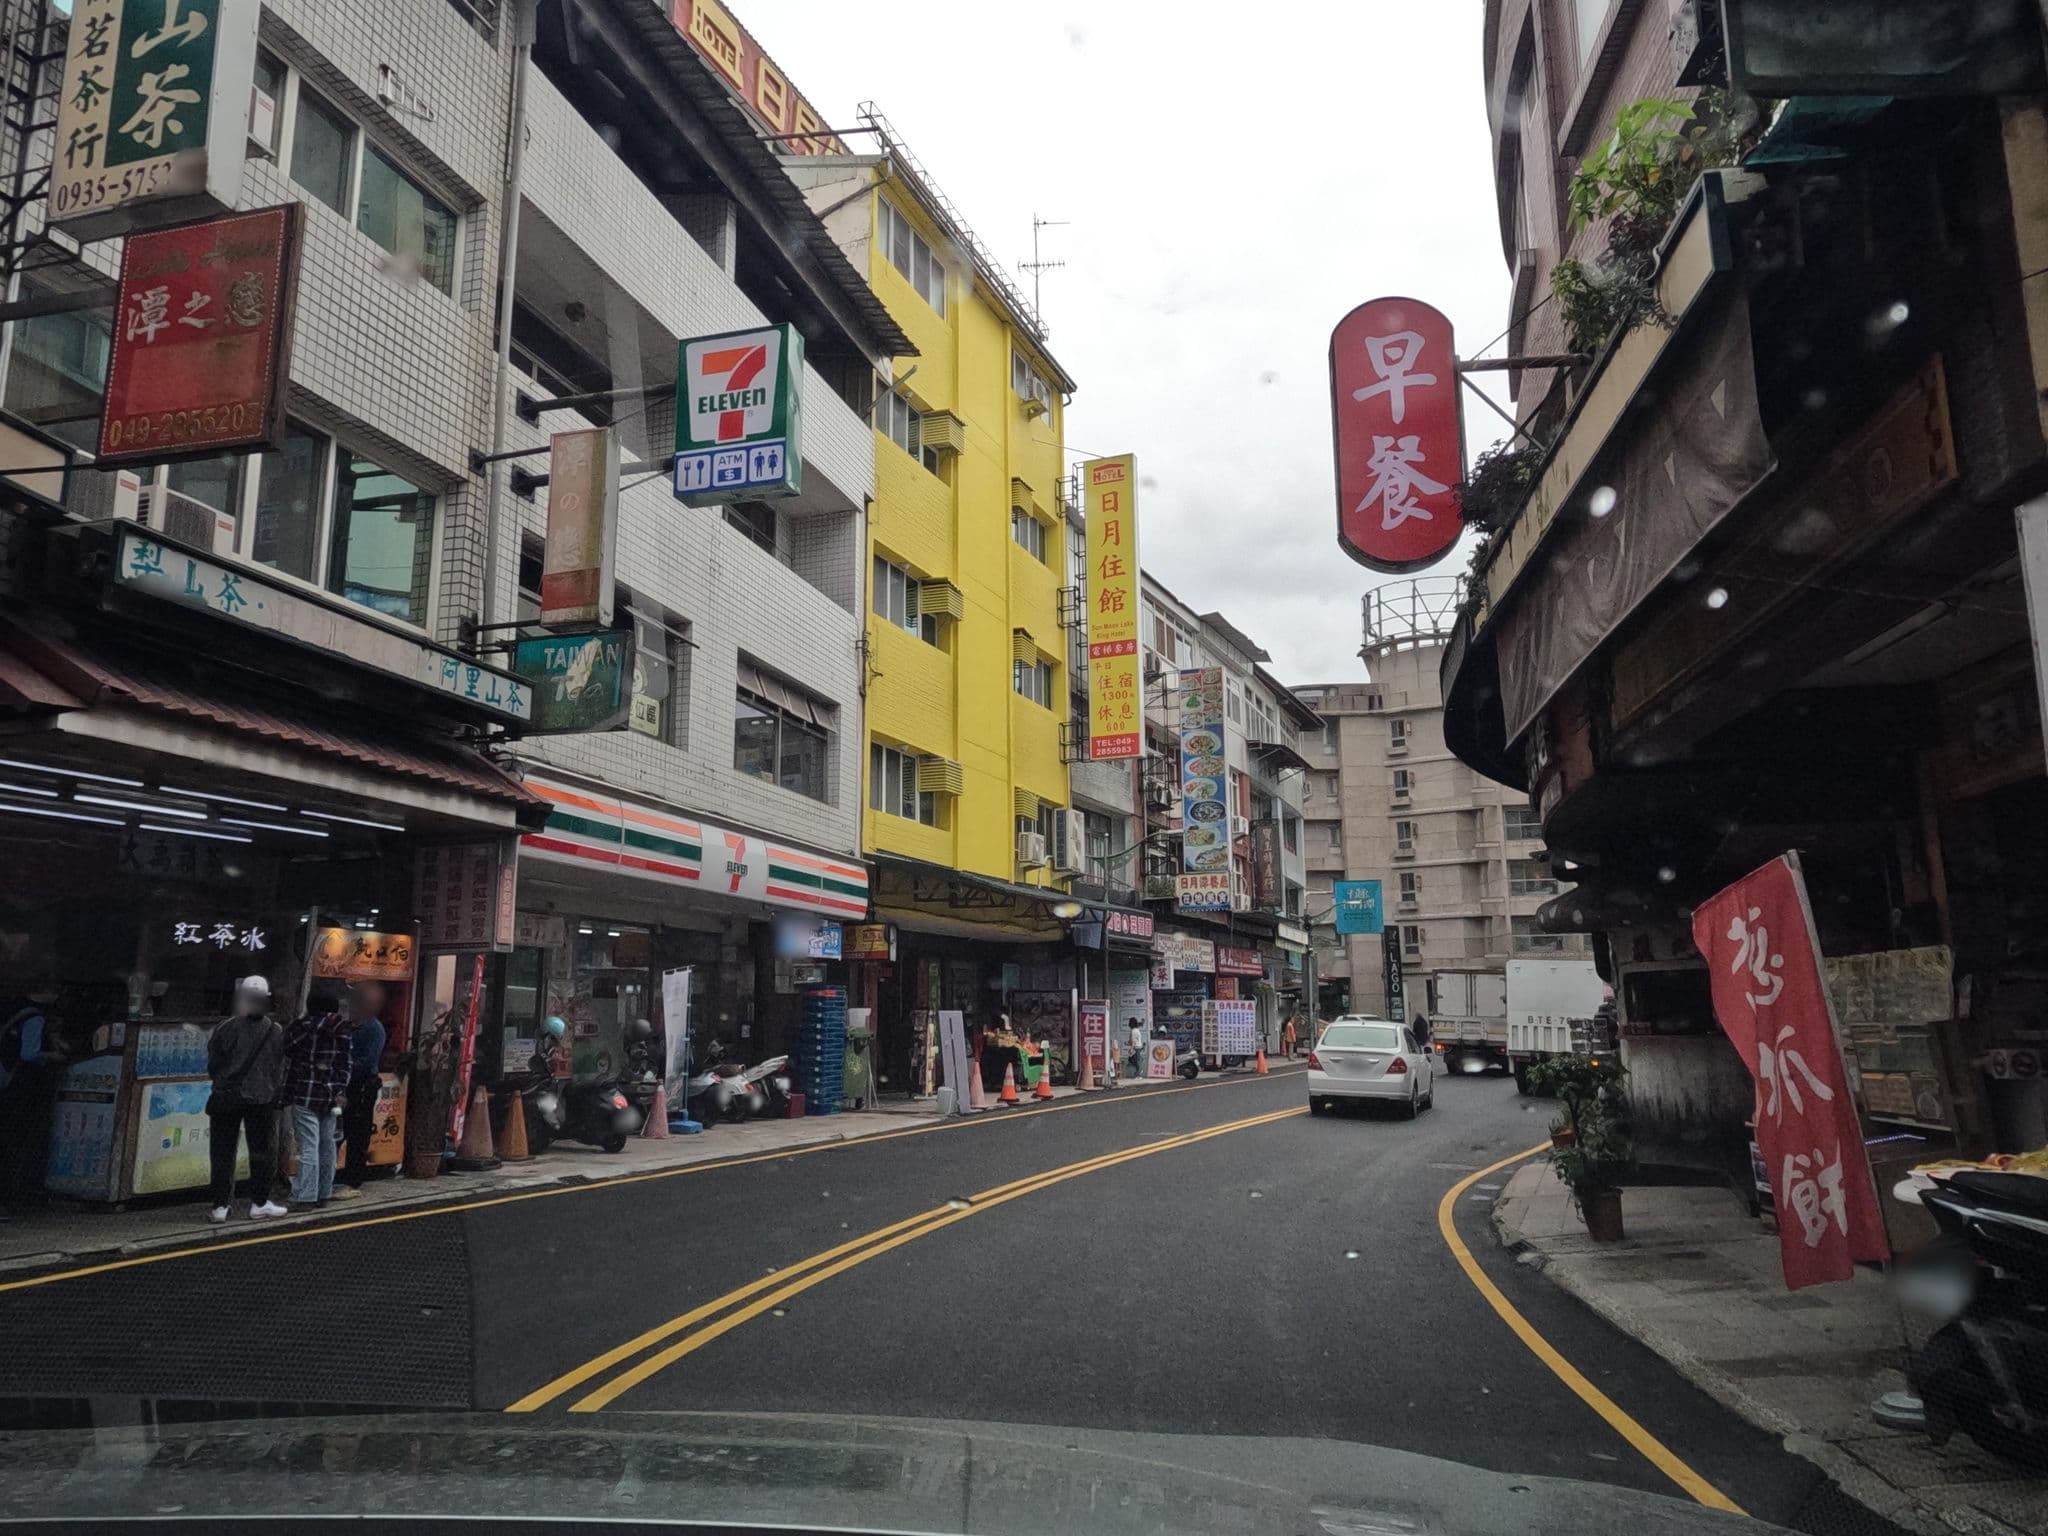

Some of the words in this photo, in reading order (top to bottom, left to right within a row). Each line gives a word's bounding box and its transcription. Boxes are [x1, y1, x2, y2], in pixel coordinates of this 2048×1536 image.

[64, 0, 116, 169] 茗茶行
[1352, 330, 1449, 531] 早餐
[718, 454, 743, 466] ATM
[1098, 490, 1127, 614] 日月住館
[439, 655, 523, 712] 阿里山茶
[1097, 672, 1133, 690] 住宿
[1098, 702, 1135, 721] 休息
[1106, 721, 1126, 732] 600
[174, 922, 266, 951] 紅茶冰
[1390, 951, 1400, 993] LAGO
[1083, 1013, 1103, 1057] 住宿
